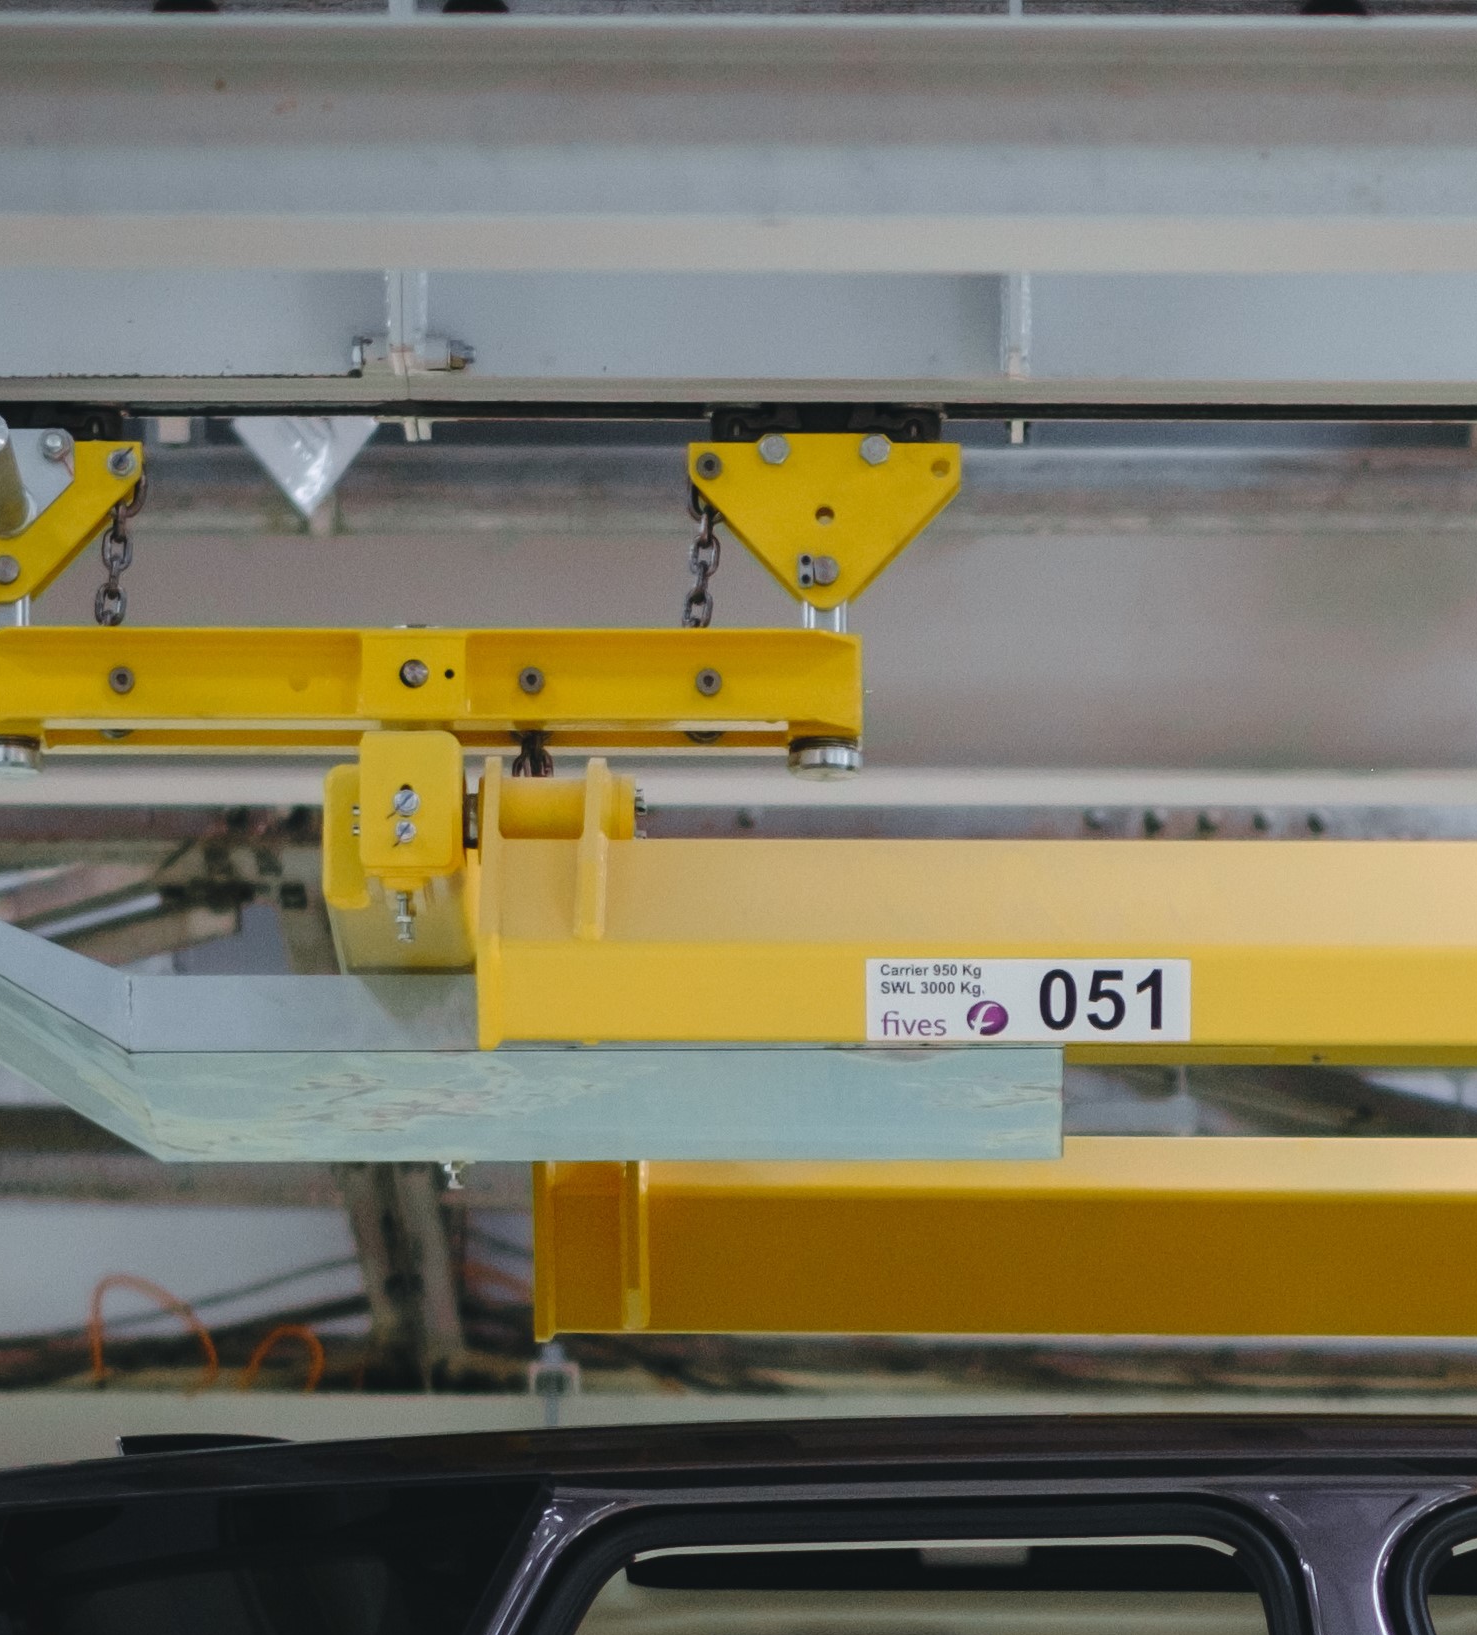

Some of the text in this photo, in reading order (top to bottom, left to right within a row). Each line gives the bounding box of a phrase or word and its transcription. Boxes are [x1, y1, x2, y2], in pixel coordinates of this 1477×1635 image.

[880, 963, 982, 979] Carrier 950 Kg
[880, 980, 916, 995] SWL
[920, 980, 956, 995] 3000
[1039, 968, 1163, 1031] 051
[881, 1010, 947, 1037] fives
